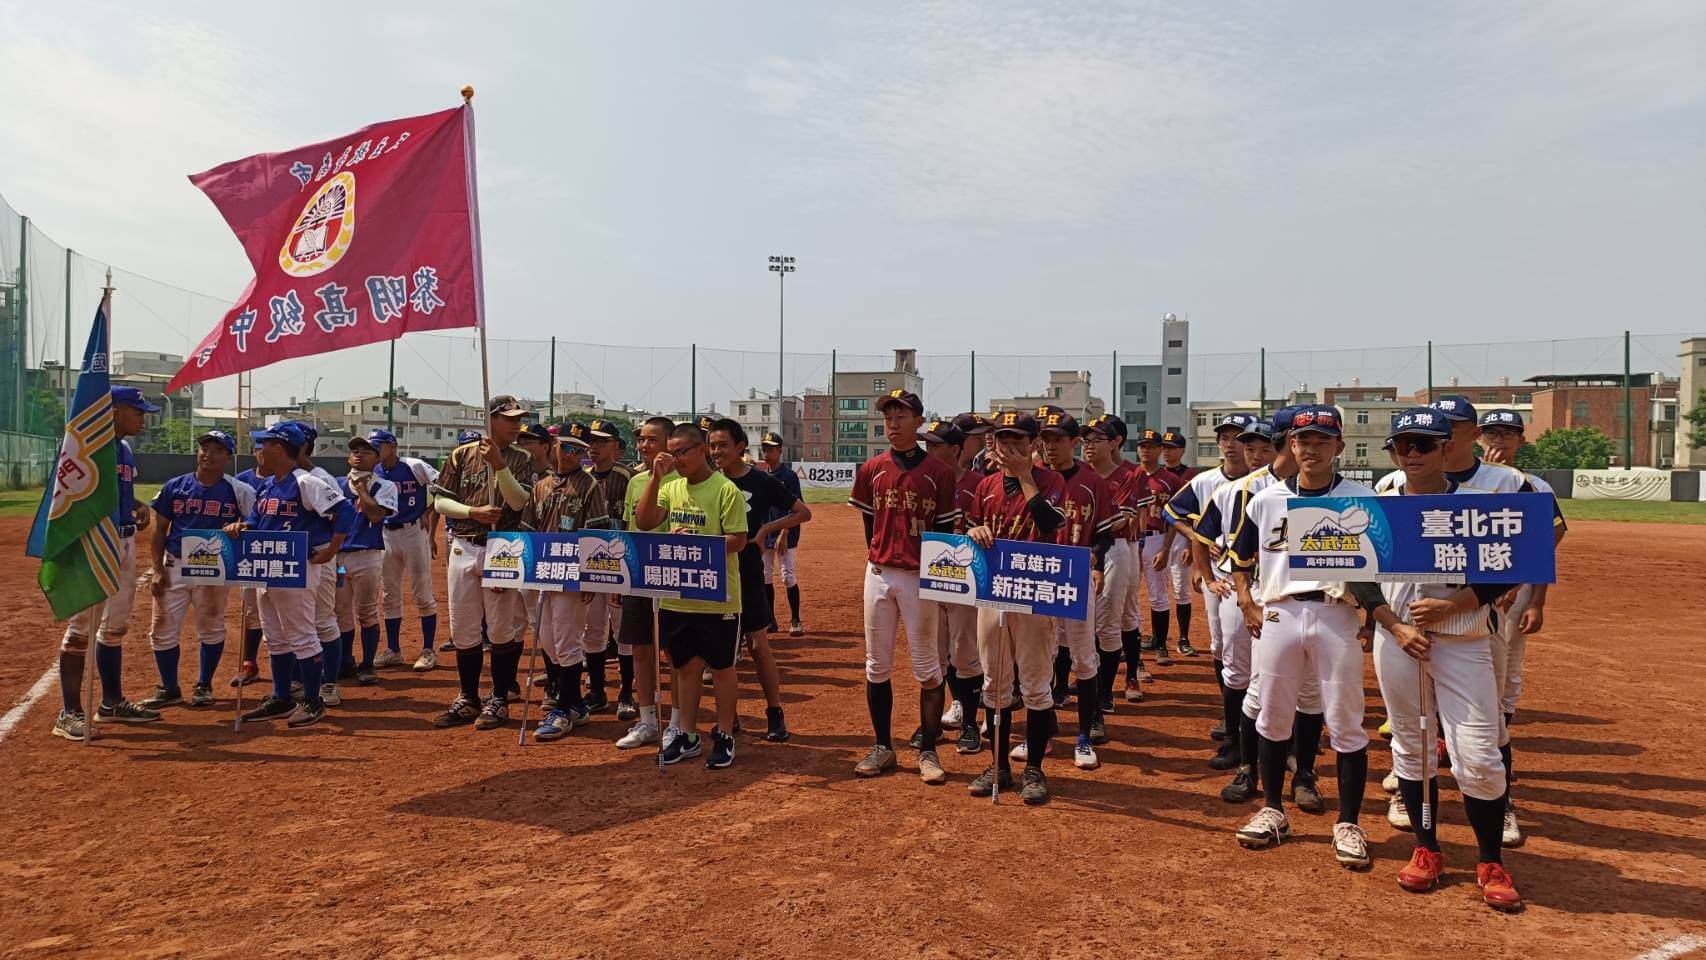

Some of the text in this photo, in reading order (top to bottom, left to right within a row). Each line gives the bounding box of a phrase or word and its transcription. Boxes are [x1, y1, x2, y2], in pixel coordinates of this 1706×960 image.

[1003, 413, 1017, 425] H
[1046, 414, 1060, 426] H
[1397, 413, 1433, 429] 北聯
[1484, 412, 1514, 424] 北聯
[1145, 430, 1154, 439] H
[808, 467, 834, 482] 823
[408, 496, 416, 507] 8
[1421, 508, 1523, 538] 臺北市
[250, 540, 288, 555] 金門縣
[1300, 535, 1361, 551] 太武盃
[658, 543, 702, 563] 臺南市
[1434, 543, 1513, 572] 聯隊
[237, 558, 300, 578] 金門農工
[489, 558, 519, 569] 太武盃
[585, 559, 621, 572] 太武盃
[1010, 552, 1062, 575] 高雄市
[1305, 557, 1355, 568] 高中青棒組
[535, 561, 580, 582] 黎明高
[644, 565, 718, 590] 陽明工商
[928, 565, 967, 580] 太武盃
[991, 574, 1078, 607] 新莊高中
